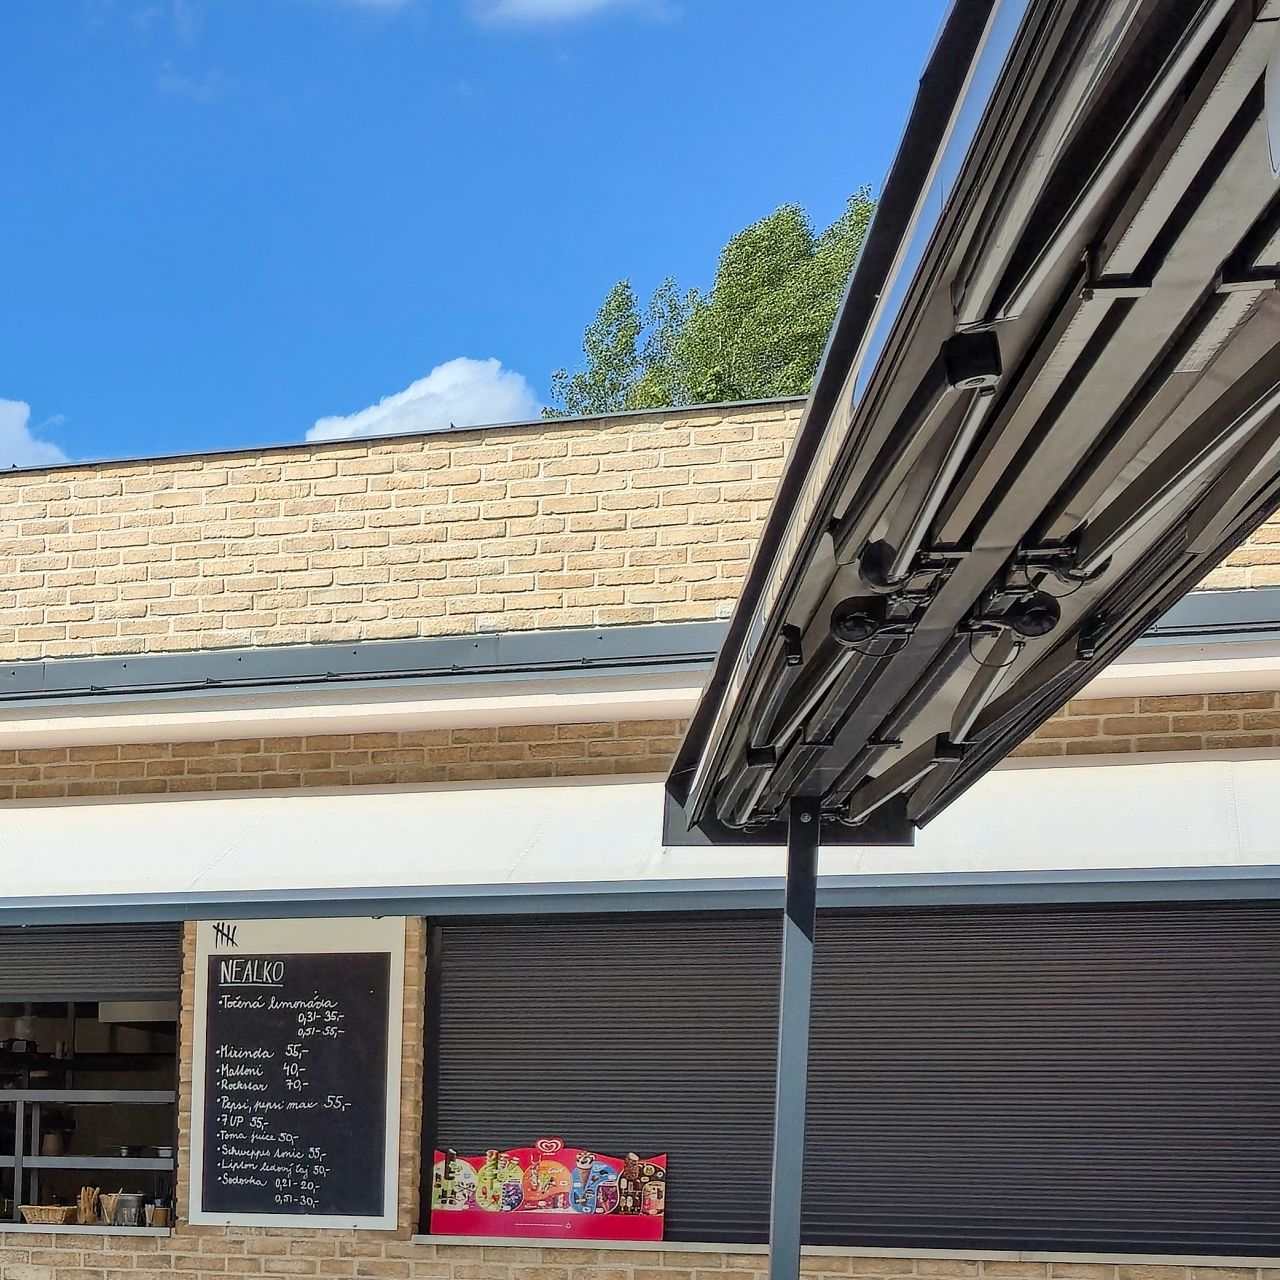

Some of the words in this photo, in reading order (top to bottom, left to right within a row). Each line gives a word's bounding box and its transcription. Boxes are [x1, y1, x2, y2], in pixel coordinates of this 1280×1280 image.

[220, 959, 285, 983] NEALKO
[221, 994, 265, 1009] Točená
[268, 995, 338, 1010] limonáda
[220, 1044, 275, 1059] Mirinda
[221, 1079, 268, 1091] Rockstar
[220, 1095, 252, 1114] Pepsi,
[253, 1100, 285, 1113] pepsi
[286, 1101, 318, 1110] max
[220, 1130, 247, 1140] Toma
[250, 1131, 276, 1144] juice
[221, 1144, 271, 1160] Schweppes
[274, 1148, 304, 1159] tonic
[221, 1159, 258, 1171] Lipton
[260, 1162, 295, 1178] ledový
[221, 1172, 268, 1187] Sodovka
